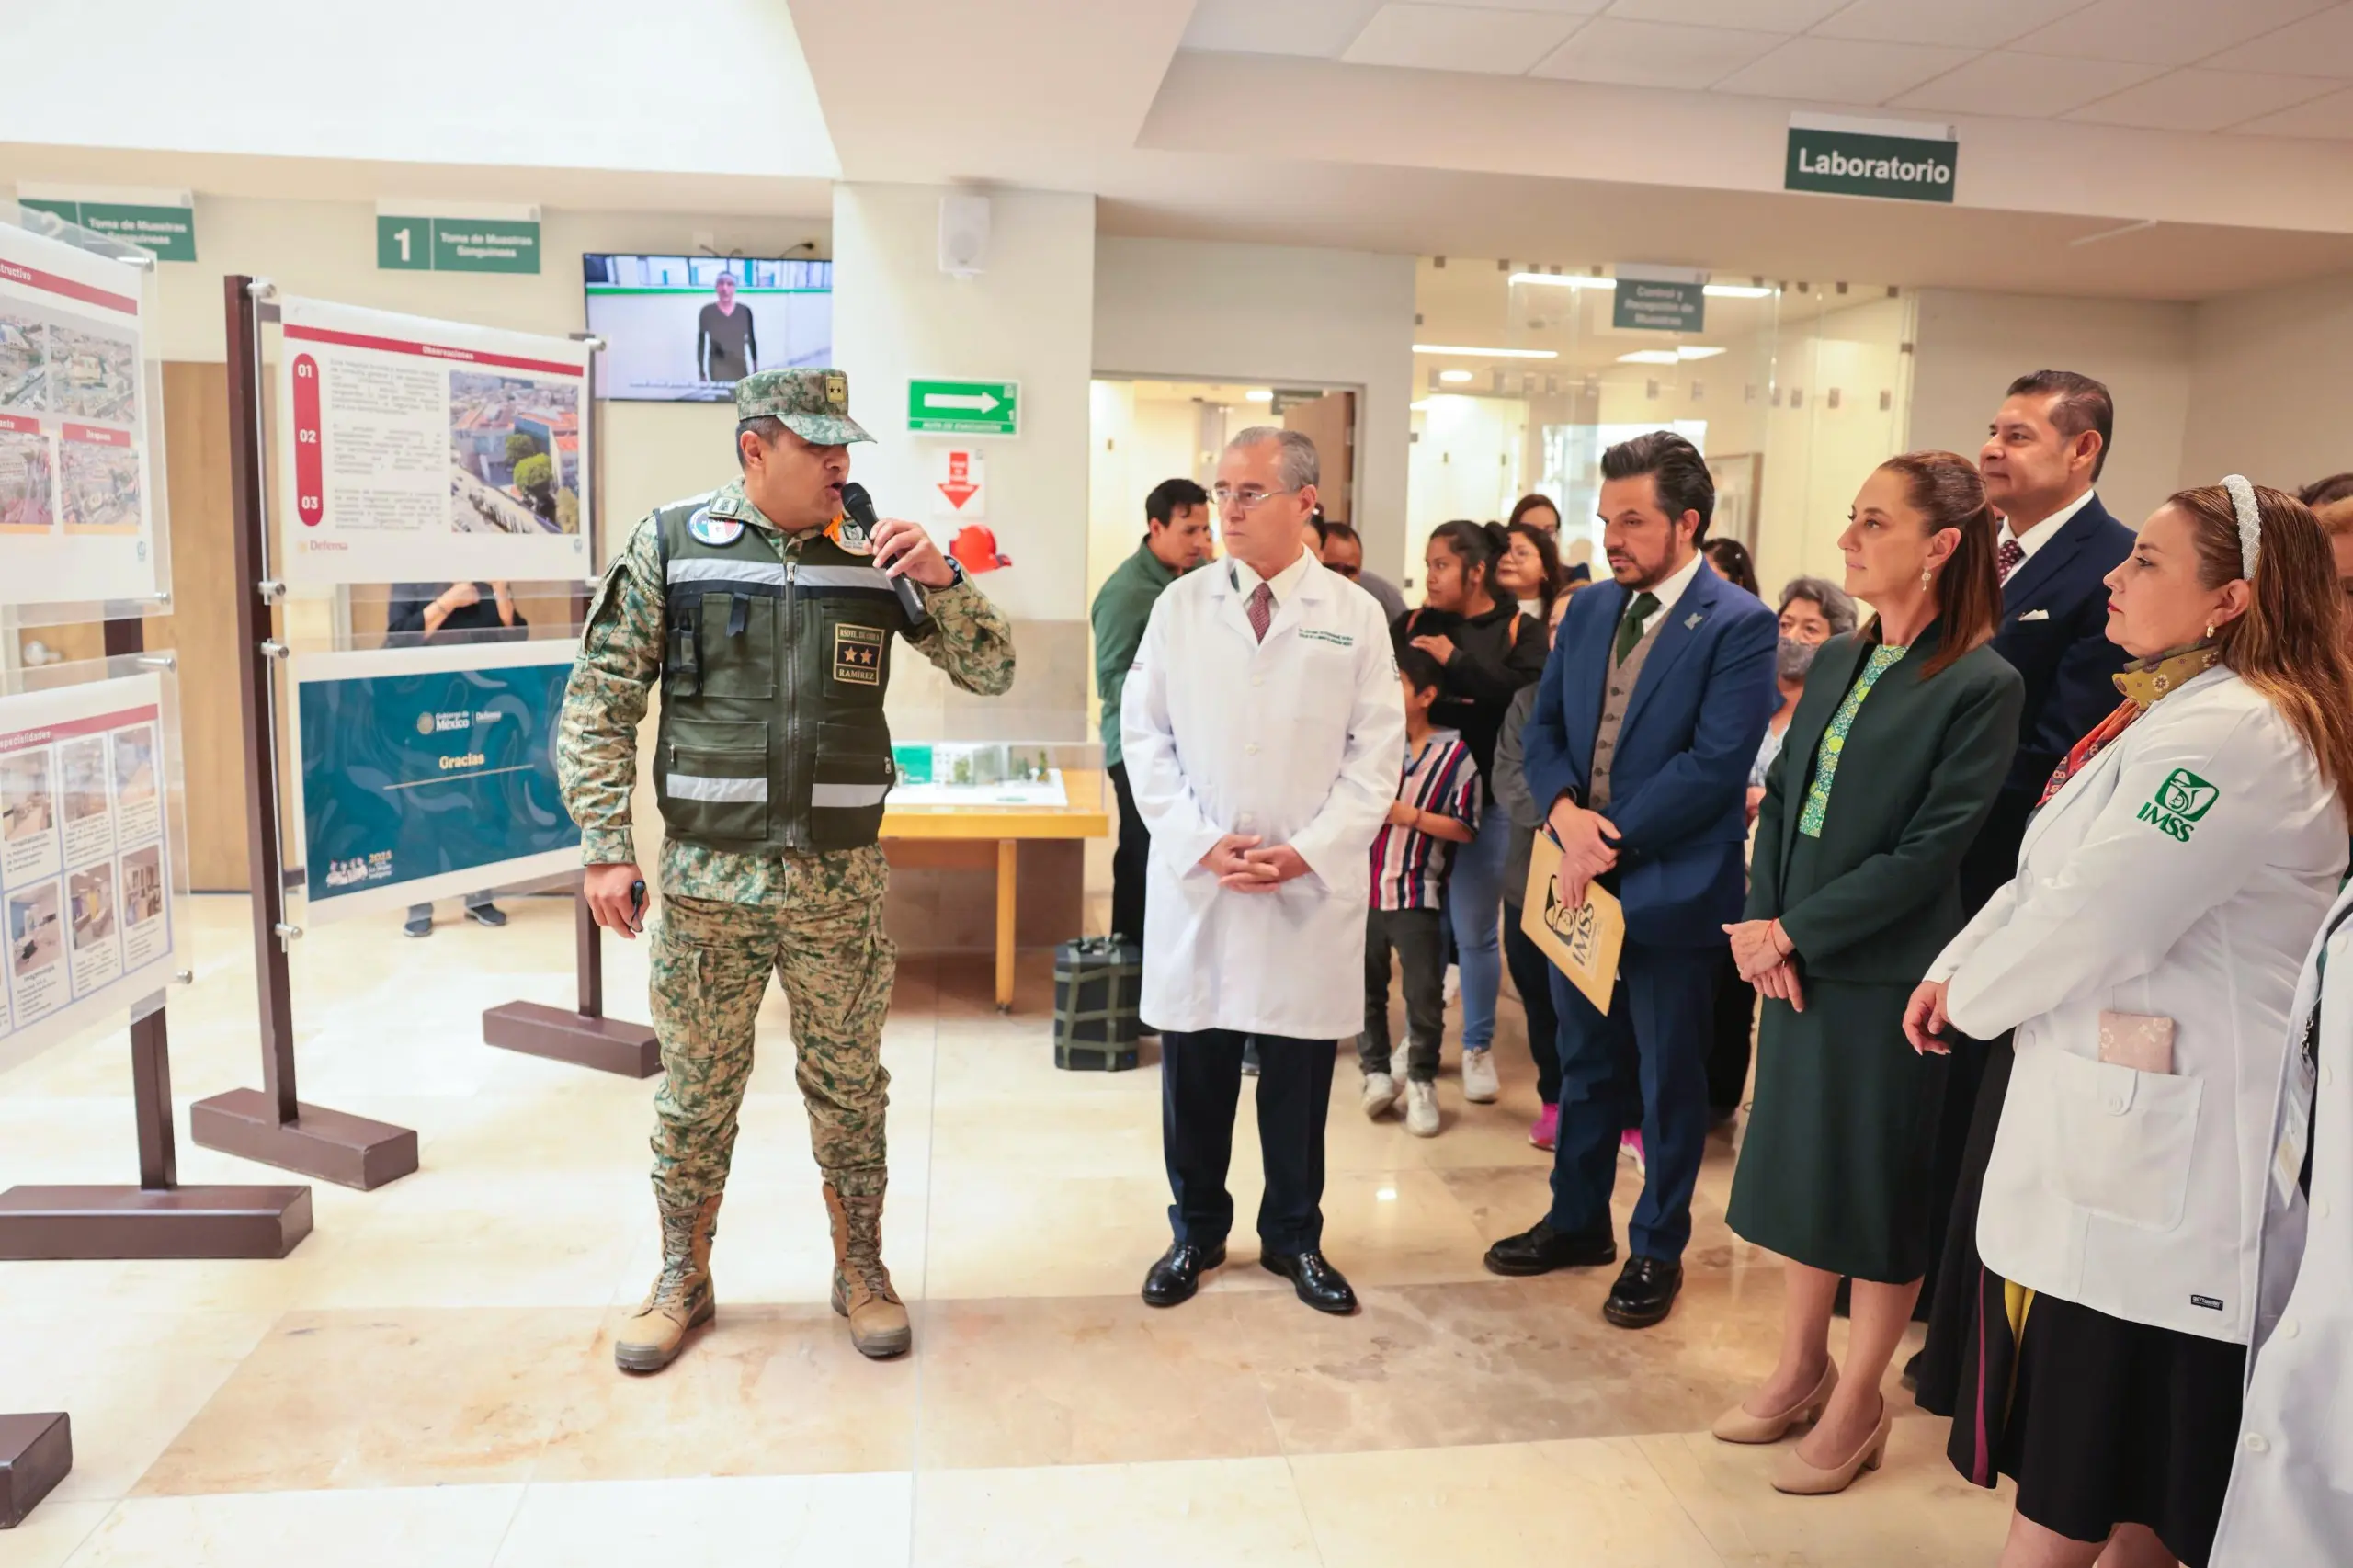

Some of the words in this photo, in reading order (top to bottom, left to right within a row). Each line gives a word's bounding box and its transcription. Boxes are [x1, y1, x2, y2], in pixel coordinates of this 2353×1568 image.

[1799, 147, 1950, 185] Laboratorio
[88, 217, 119, 229] Toma
[120, 219, 135, 230] de
[137, 220, 187, 233] Muestras
[394, 228, 410, 261] 1
[440, 232, 469, 244] Toma
[470, 233, 484, 244] de
[485, 233, 533, 246] Muestras
[298, 364, 313, 378] 01
[300, 428, 316, 444] 02
[301, 495, 318, 510] 03
[310, 539, 348, 551] Defensa
[436, 717, 470, 732] México
[439, 753, 485, 769] Gracias
[2136, 801, 2195, 843] IMSS
[1573, 903, 1594, 966] IMSS
